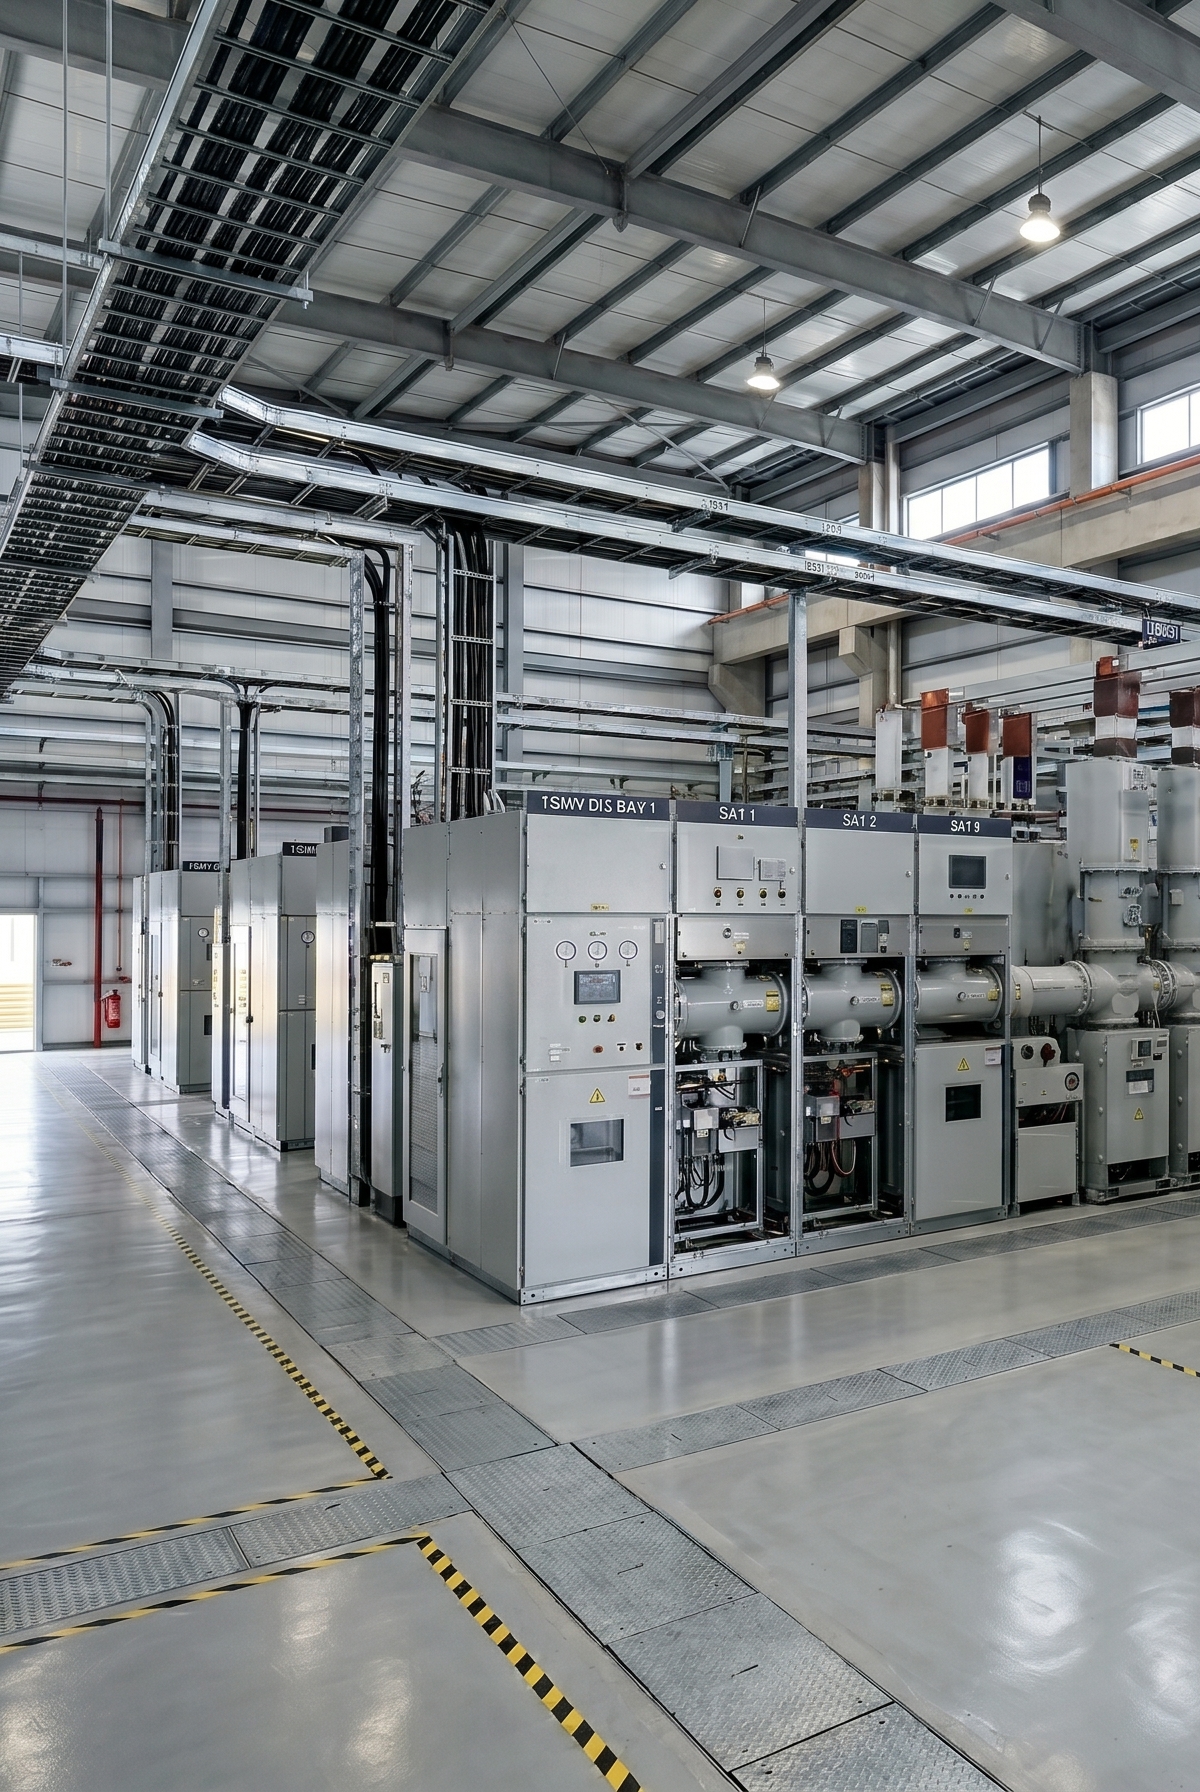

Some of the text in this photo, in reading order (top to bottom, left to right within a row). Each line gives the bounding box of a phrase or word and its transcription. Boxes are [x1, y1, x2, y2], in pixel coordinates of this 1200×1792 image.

[588, 798, 613, 813] DIS
[616, 800, 647, 815] BAY
[650, 802, 655, 814] 1
[842, 814, 877, 828] SA1 2
[950, 820, 981, 833] SA1 9
